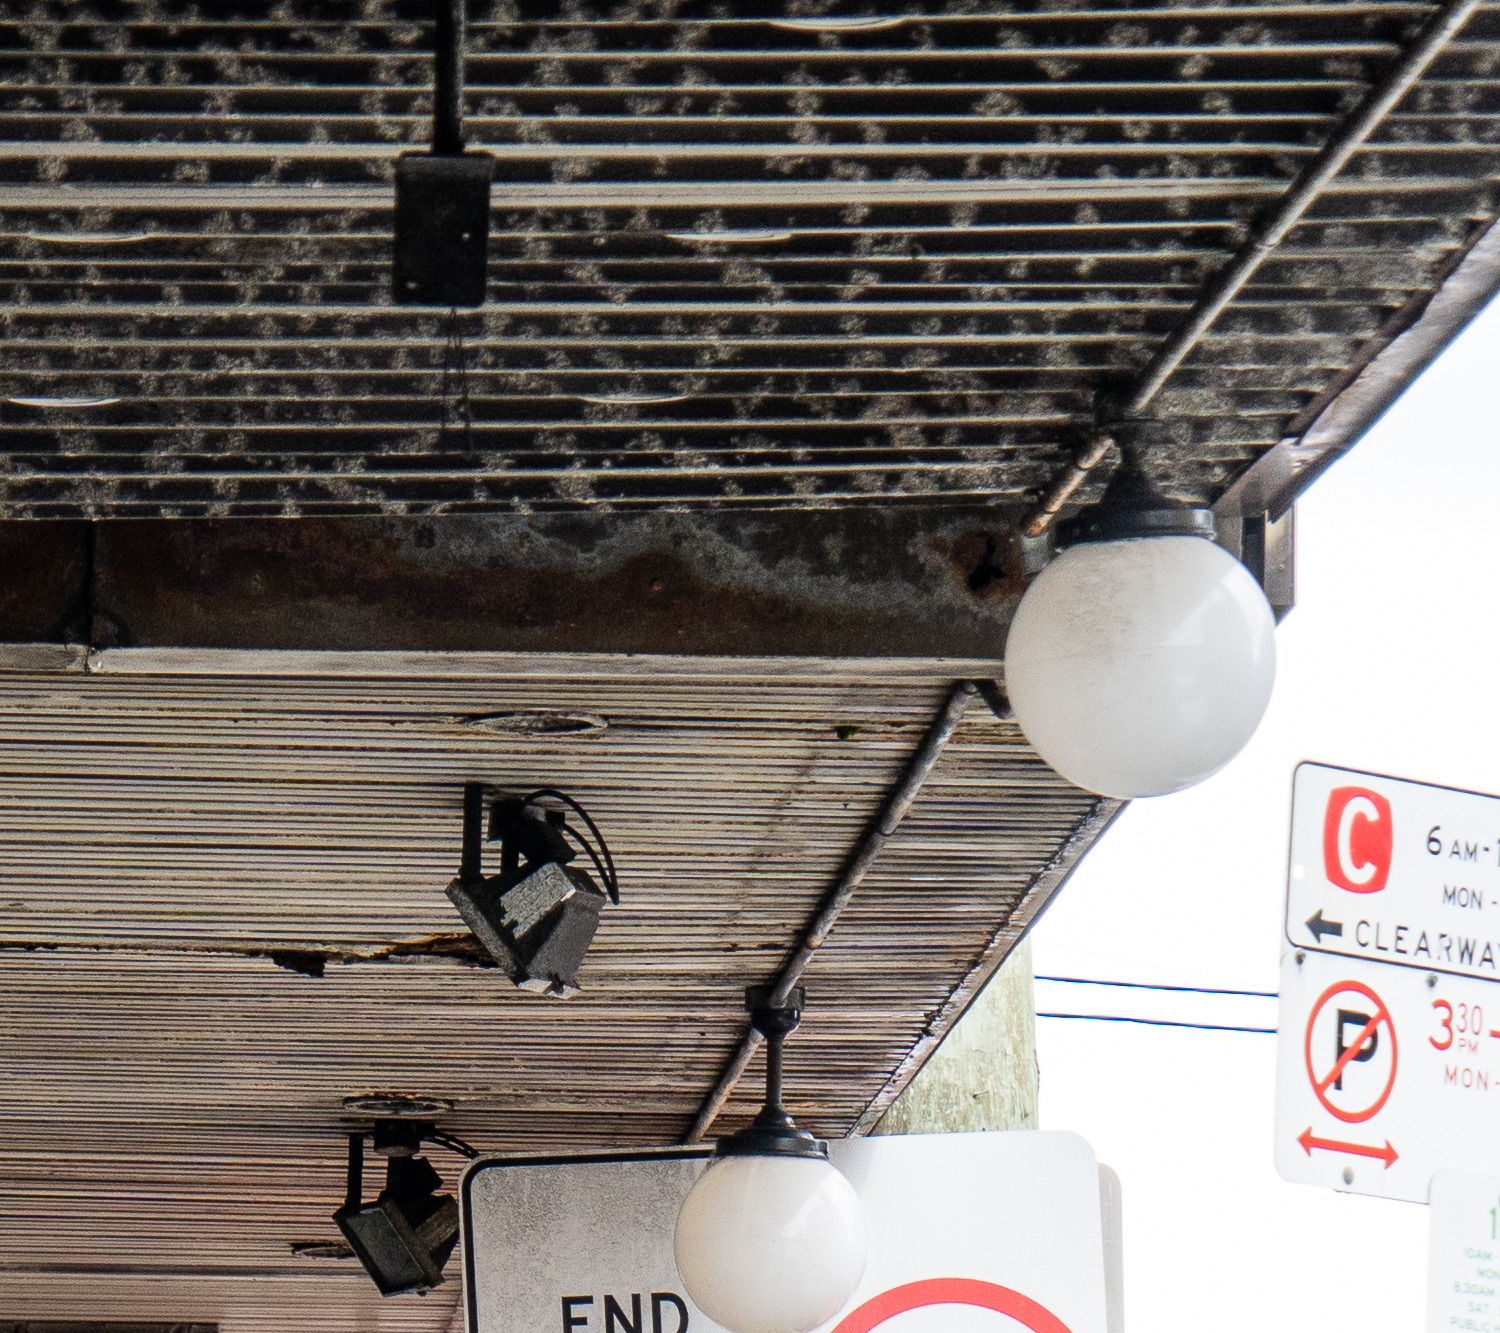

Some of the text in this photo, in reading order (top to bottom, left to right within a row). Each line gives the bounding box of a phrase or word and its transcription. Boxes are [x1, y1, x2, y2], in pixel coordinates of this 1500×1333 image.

[1427, 826, 1442, 856] 6
[1449, 839, 1478, 863] AM
[1443, 884, 1483, 910] MON
[1450, 1317, 1491, 1332] PUBLIC
